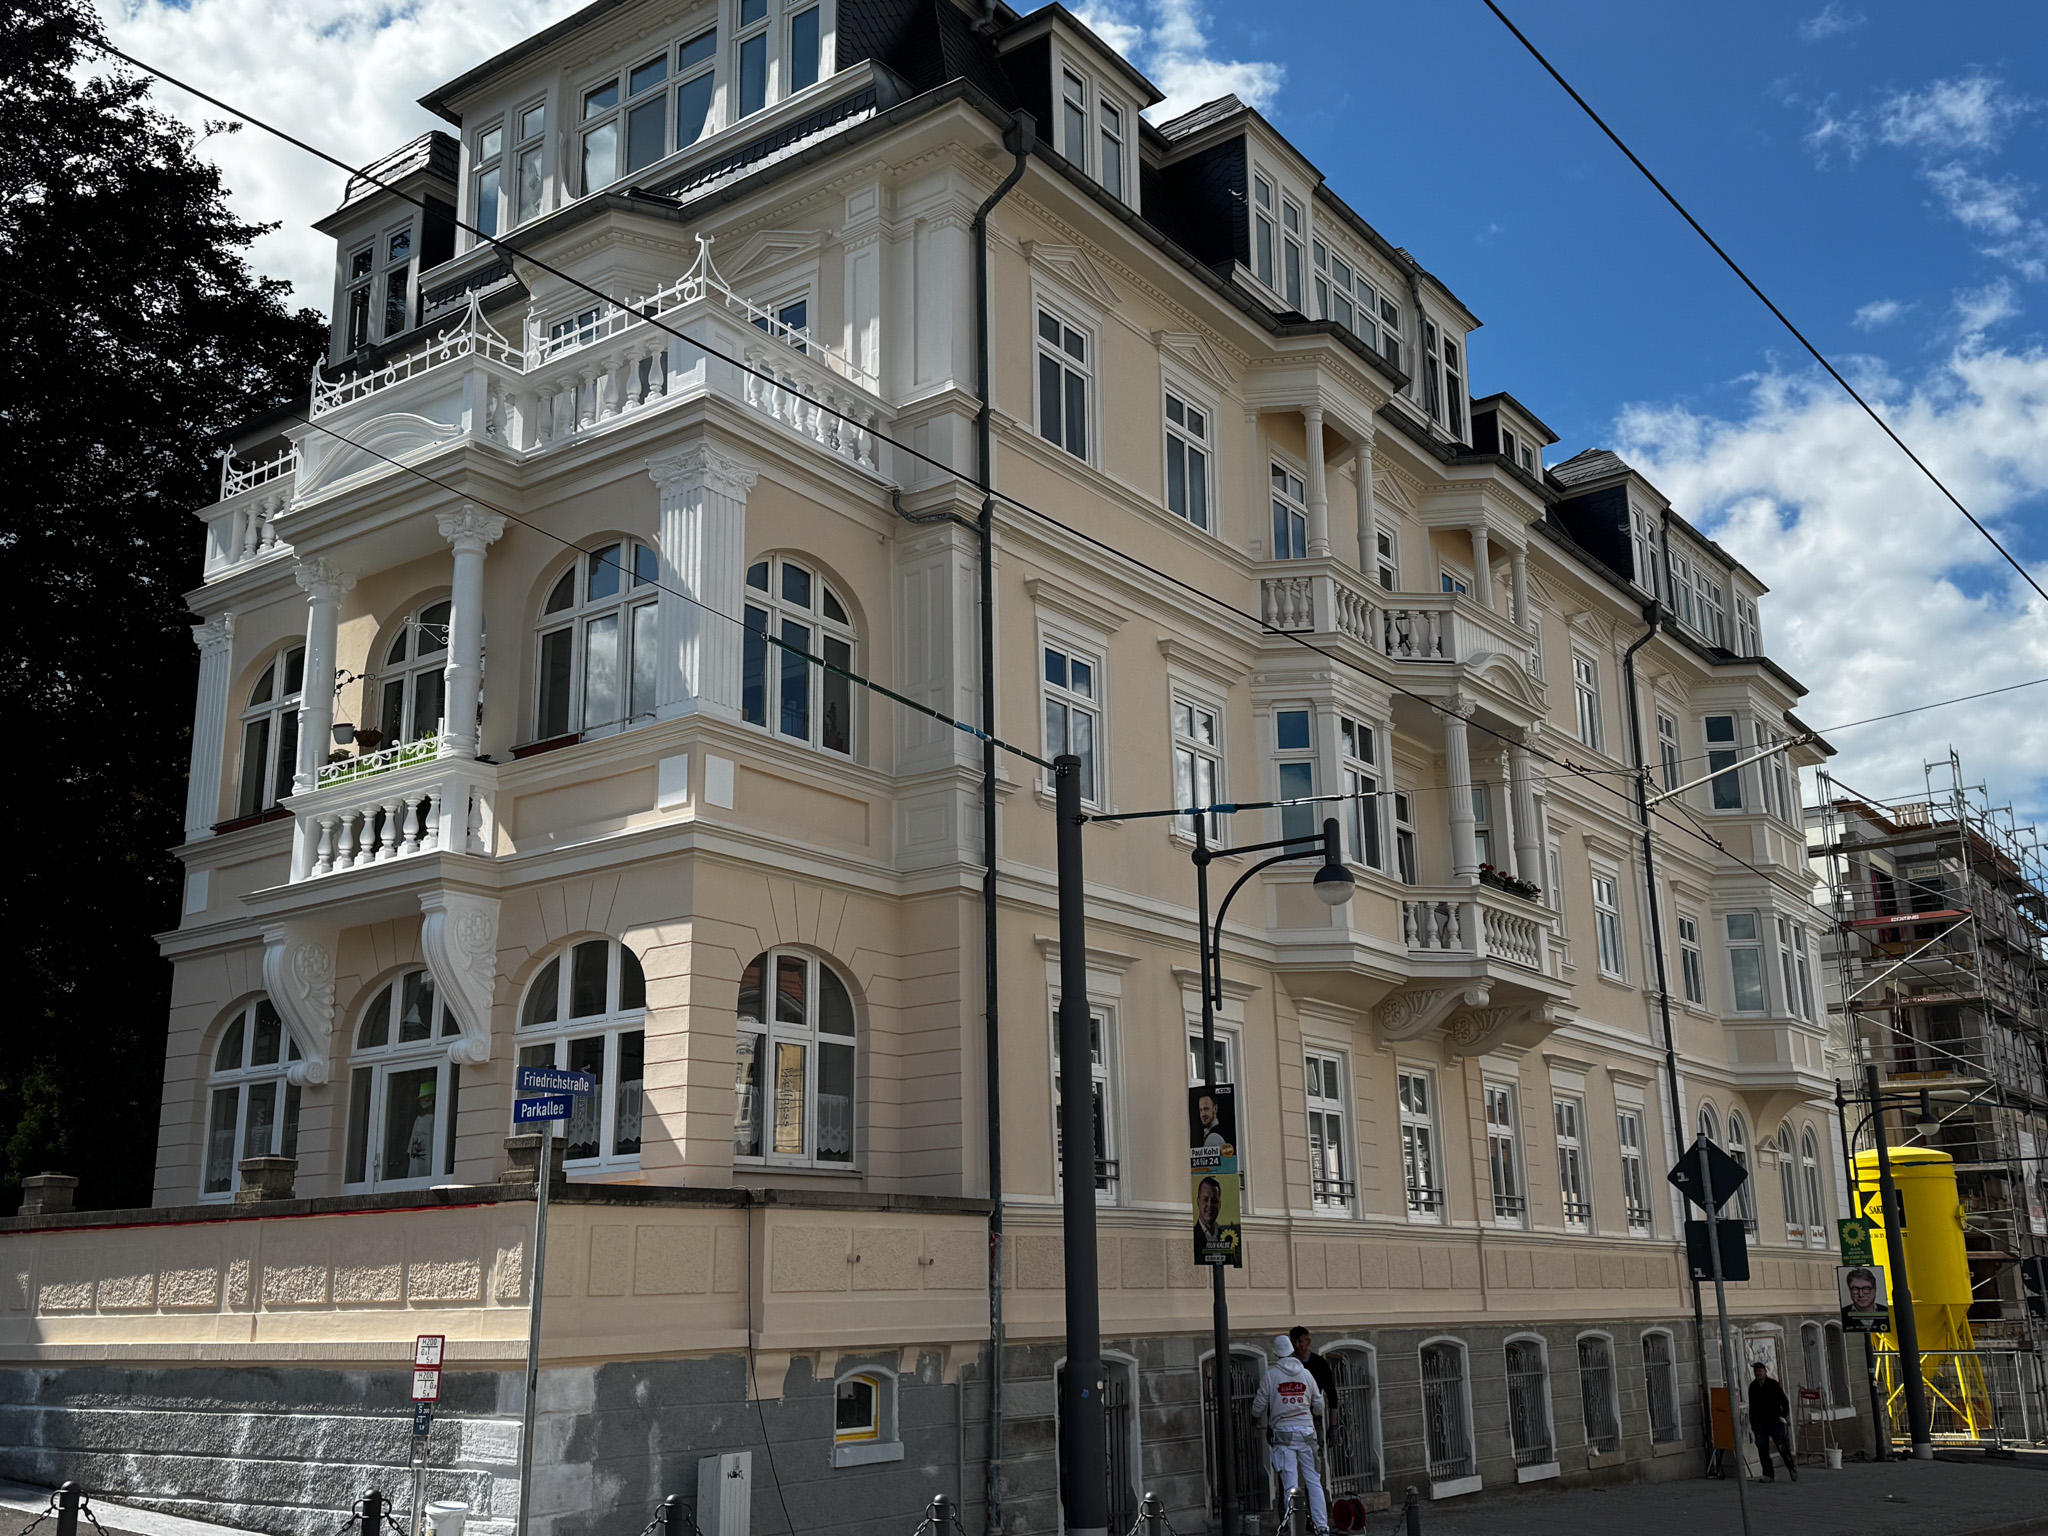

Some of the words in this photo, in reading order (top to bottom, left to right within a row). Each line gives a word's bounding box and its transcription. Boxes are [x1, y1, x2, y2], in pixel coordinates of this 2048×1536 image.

[523, 1071, 589, 1092] Friedrichstraße
[781, 1067, 794, 1128] Wellness
[521, 1101, 564, 1118] Parkallee
[1192, 1149, 1203, 1157] Paul
[1204, 1147, 1219, 1156] Kohl
[1192, 1158, 1200, 1166] 24
[1200, 1157, 1209, 1166] für
[1209, 1157, 1219, 1165] 24
